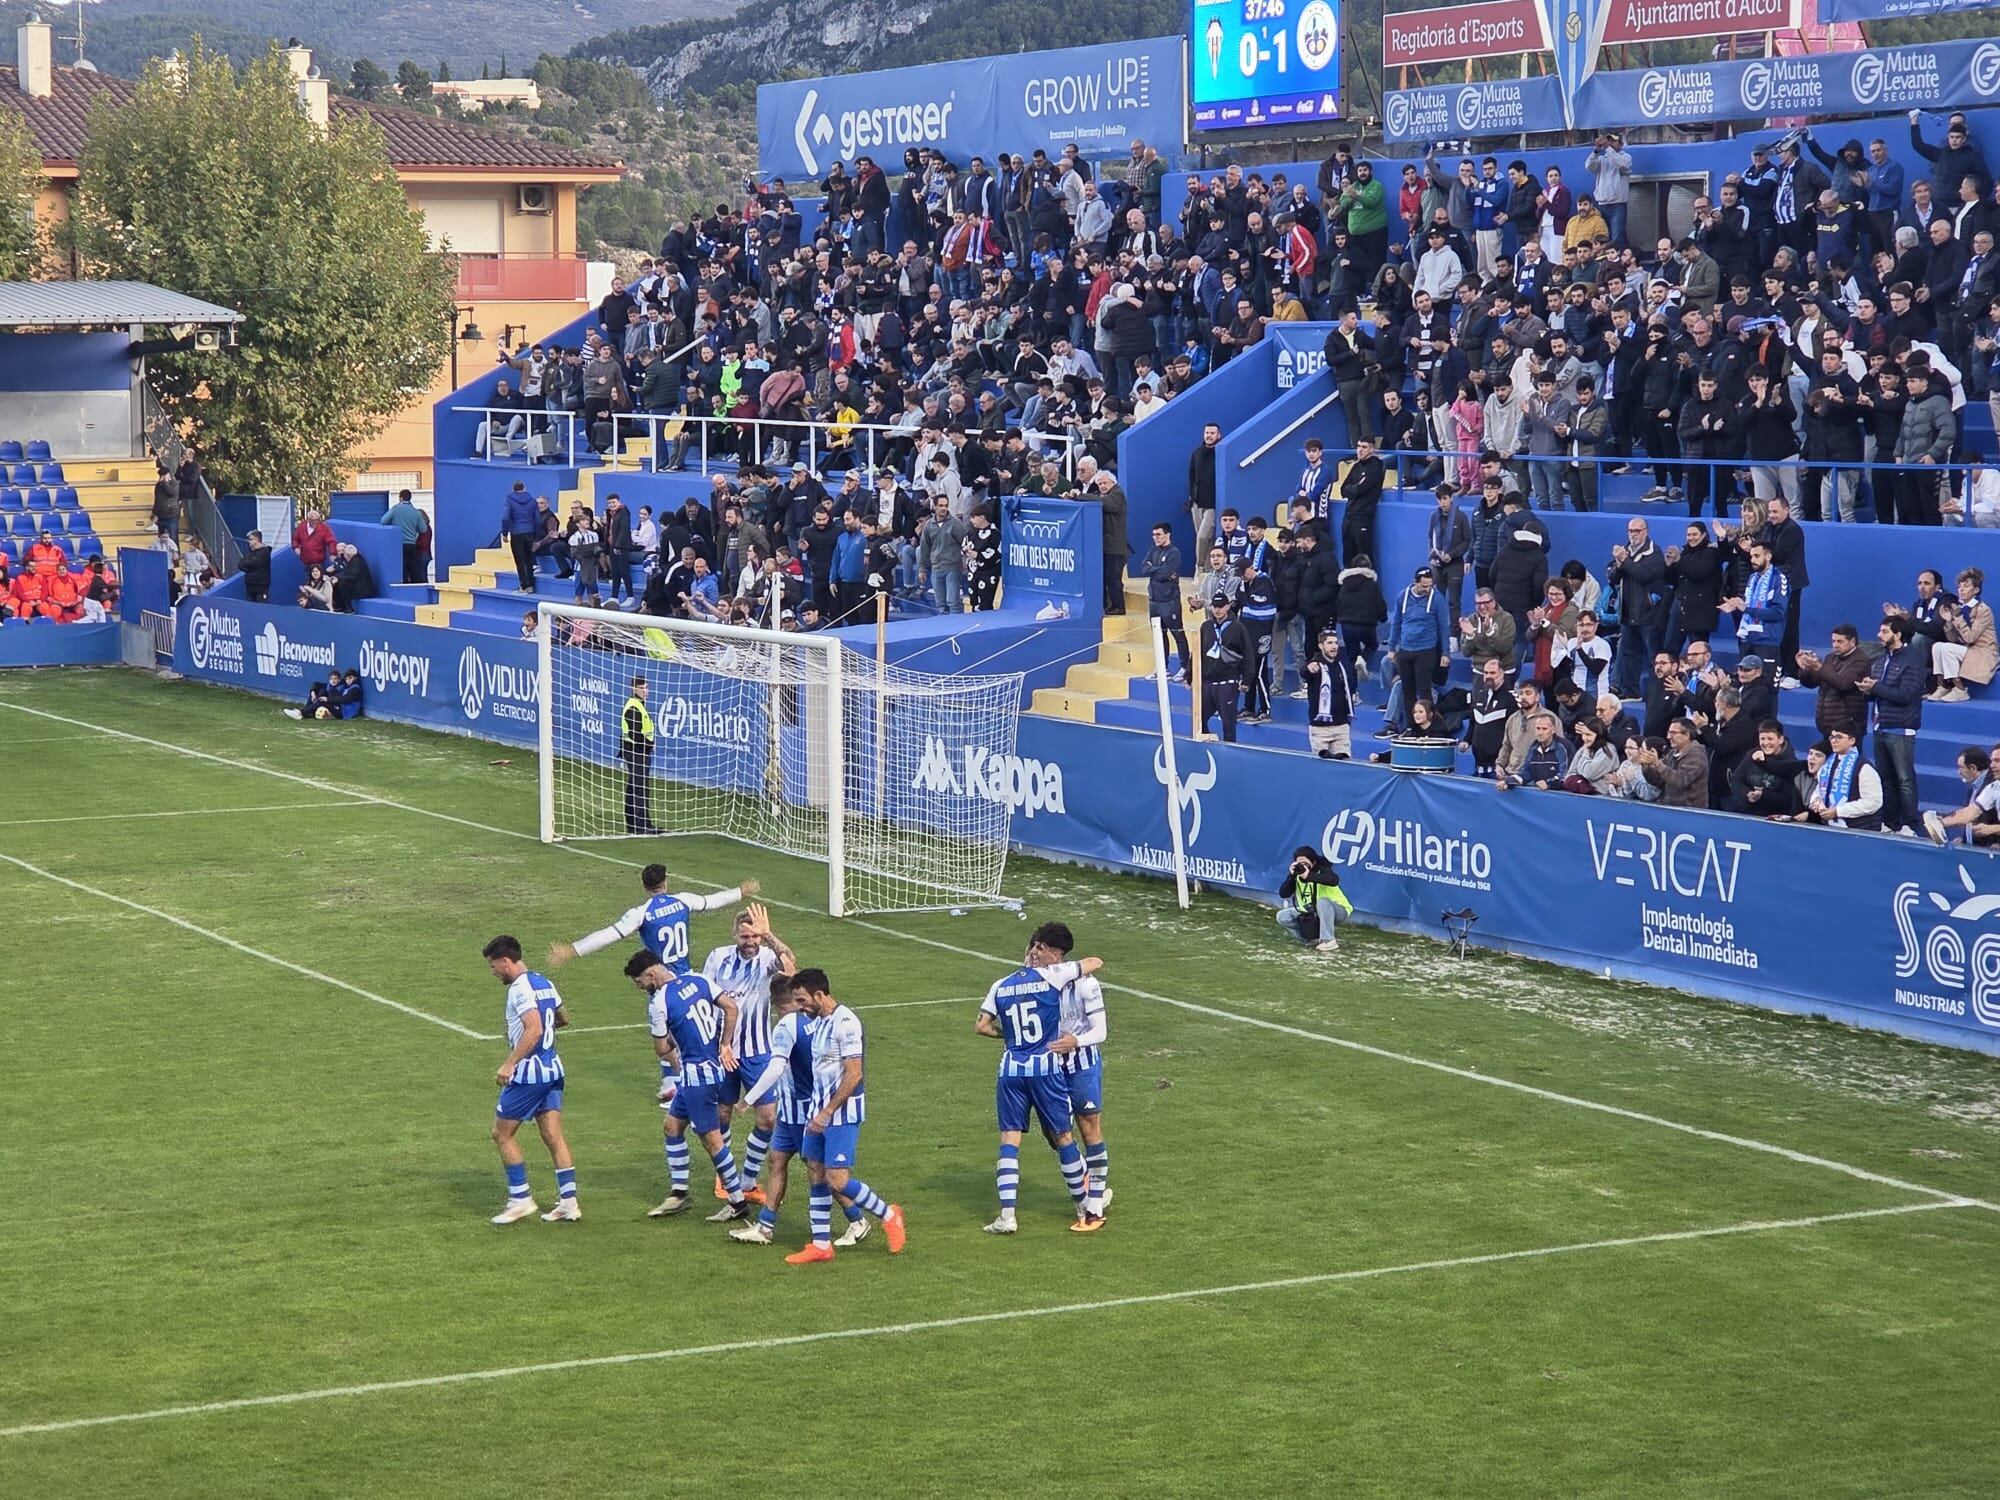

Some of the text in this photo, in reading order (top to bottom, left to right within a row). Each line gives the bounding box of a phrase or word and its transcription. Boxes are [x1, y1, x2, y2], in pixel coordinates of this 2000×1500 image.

[1625, 0, 1720, 32] Ajuntament
[1391, 17, 1524, 55] Regidoría d'Esports
[1772, 60, 1820, 81] Mutua
[1886, 52, 1937, 73] Mutua
[1668, 69, 1712, 89] Mutua
[1771, 79, 1823, 99] Levante
[1884, 72, 1939, 91] Levante
[1025, 73, 1101, 117] GROW
[1410, 92, 1446, 110] Mutua
[1483, 85, 1521, 103] Mutua
[1666, 88, 1714, 105] Levante
[1770, 97, 1823, 110] SEGUROS
[1883, 89, 1940, 102] SEGUROS
[1409, 109, 1449, 125] Levante
[1481, 101, 1523, 119] Levante
[1481, 117, 1524, 129] SEGUROS
[1665, 104, 1714, 116] SEGUROS
[1410, 125, 1449, 135] SEGUROS
[1009, 543, 1075, 572] FONT DELS PATOS
[209, 608, 241, 637] Mutua
[208, 634, 244, 660] Levante
[279, 635, 335, 667] Tecnovasol
[209, 658, 244, 674] SEGUROS
[359, 639, 430, 698] Digicopy
[485, 662, 540, 703] VIDLUX
[688, 700, 750, 743] Hilario
[965, 744, 1065, 818] Kappa
[1380, 818, 1491, 878] Hilario
[1586, 819, 1752, 903] VERICAT
[1183, 854, 1247, 884] BARBERÍA
[1641, 902, 1734, 944] Implantología
[657, 921, 689, 964] 20
[1643, 926, 1758, 969] Dental Inmediata
[1895, 988, 1965, 1016] INDUSTRIAS
[542, 1007, 555, 1050] 8
[686, 998, 718, 1046] 18
[1005, 1000, 1043, 1046] 15
